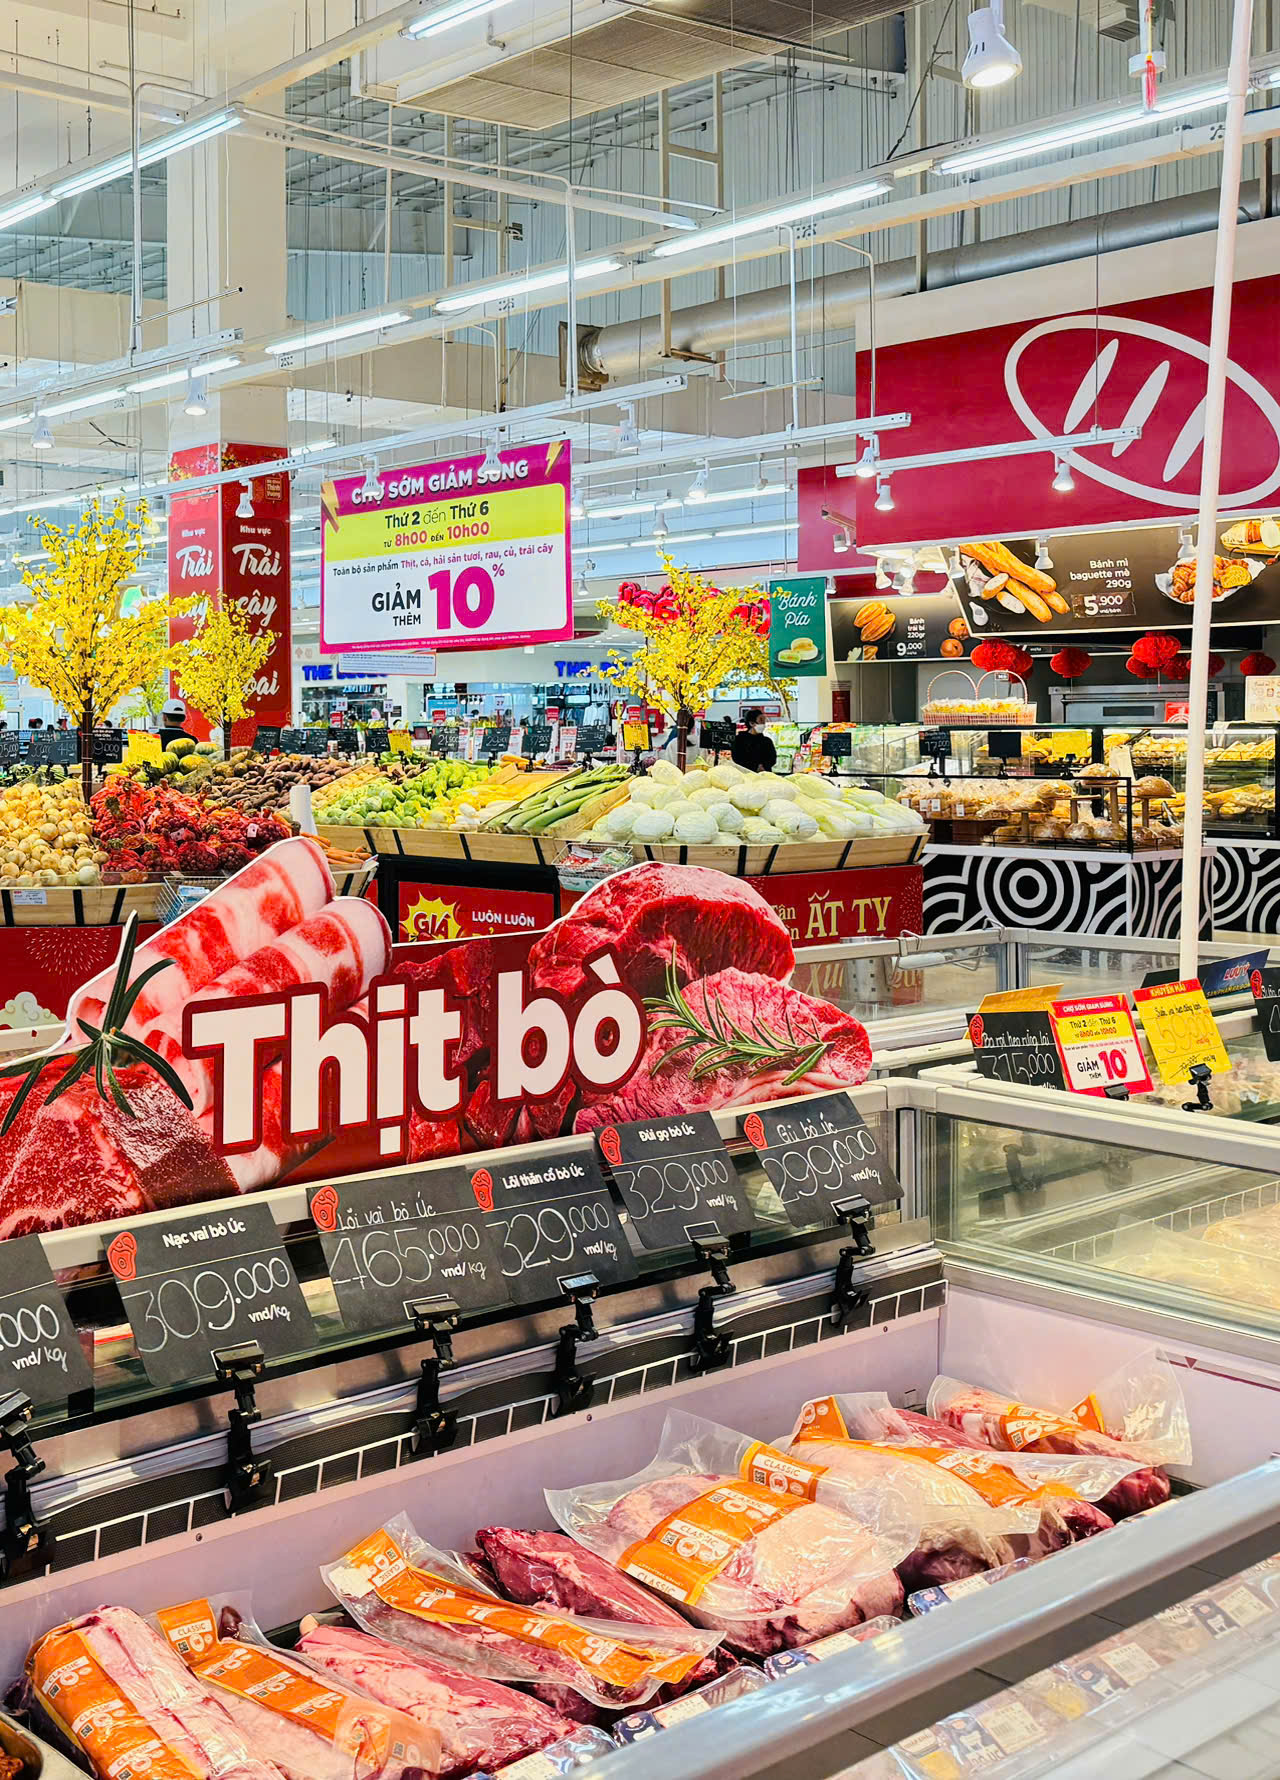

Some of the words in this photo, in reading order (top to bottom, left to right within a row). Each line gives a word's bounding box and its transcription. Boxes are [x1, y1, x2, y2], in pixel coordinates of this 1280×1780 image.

[389, 478, 424, 498] SỚM
[428, 465, 472, 493] GIẢM
[385, 511, 409, 529] Thứ
[411, 511, 420, 525] 2
[423, 508, 446, 524] đến
[450, 501, 475, 520] Thứ
[480, 500, 489, 515] 6
[240, 525, 254, 533] Khu
[256, 527, 271, 536] vực
[395, 530, 427, 546] 8h00
[447, 521, 489, 539] 10h00
[176, 544, 214, 579] Trái
[232, 543, 282, 576] Trái
[333, 566, 350, 576] Toàn
[351, 564, 361, 575] bộ
[363, 563, 375, 573] sản
[377, 561, 399, 575] phẩm
[447, 553, 461, 563] sản
[485, 550, 501, 560] rau,
[519, 546, 535, 555] trái
[537, 544, 553, 555] cây
[1090, 560, 1113, 568] Bánh
[1116, 557, 1128, 567] mì
[1070, 570, 1113, 581] baguette
[1115, 568, 1130, 577] mè
[1106, 579, 1132, 589] 290g
[236, 588, 277, 626] cây
[372, 582, 421, 612] GIẢM
[778, 590, 817, 611] Bánh
[393, 613, 421, 626] THÊM
[785, 610, 810, 628] Pía
[907, 631, 925, 639] 220gr
[302, 664, 332, 680] THE
[242, 671, 280, 701] oại
[472, 910, 500, 926] LUÔN
[502, 913, 535, 928] LUÔN
[1082, 1019, 1087, 1027] 2
[191, 984, 461, 1155] Thịt
[498, 953, 641, 1099] bò
[1077, 1057, 1099, 1072] GIẢM
[638, 1129, 656, 1142] Đùi
[670, 1126, 682, 1138] bò
[682, 1123, 695, 1137] Úc
[800, 1117, 818, 1138] bò
[819, 1112, 838, 1135] Úc
[503, 1175, 520, 1190] Lõi
[519, 1170, 545, 1187] thăn
[557, 1167, 570, 1180] bò
[570, 1163, 585, 1178] Úc
[762, 1129, 877, 1204] 299.000
[613, 1159, 729, 1220] 329.000
[337, 1208, 359, 1231] Lõi
[364, 1205, 385, 1225] vai
[393, 1201, 410, 1221] bò
[416, 1192, 436, 1217] Úc
[162, 1232, 190, 1248] Nạc
[189, 1226, 210, 1241] vai
[210, 1222, 228, 1238] bò
[229, 1217, 247, 1233] Úc
[485, 1202, 610, 1277] 329.000
[329, 1223, 480, 1290] 465.000
[121, 1257, 290, 1352] 309.000
[763, 1458, 801, 1477] CLASSIC
[177, 1622, 207, 1636] CLASSIC
